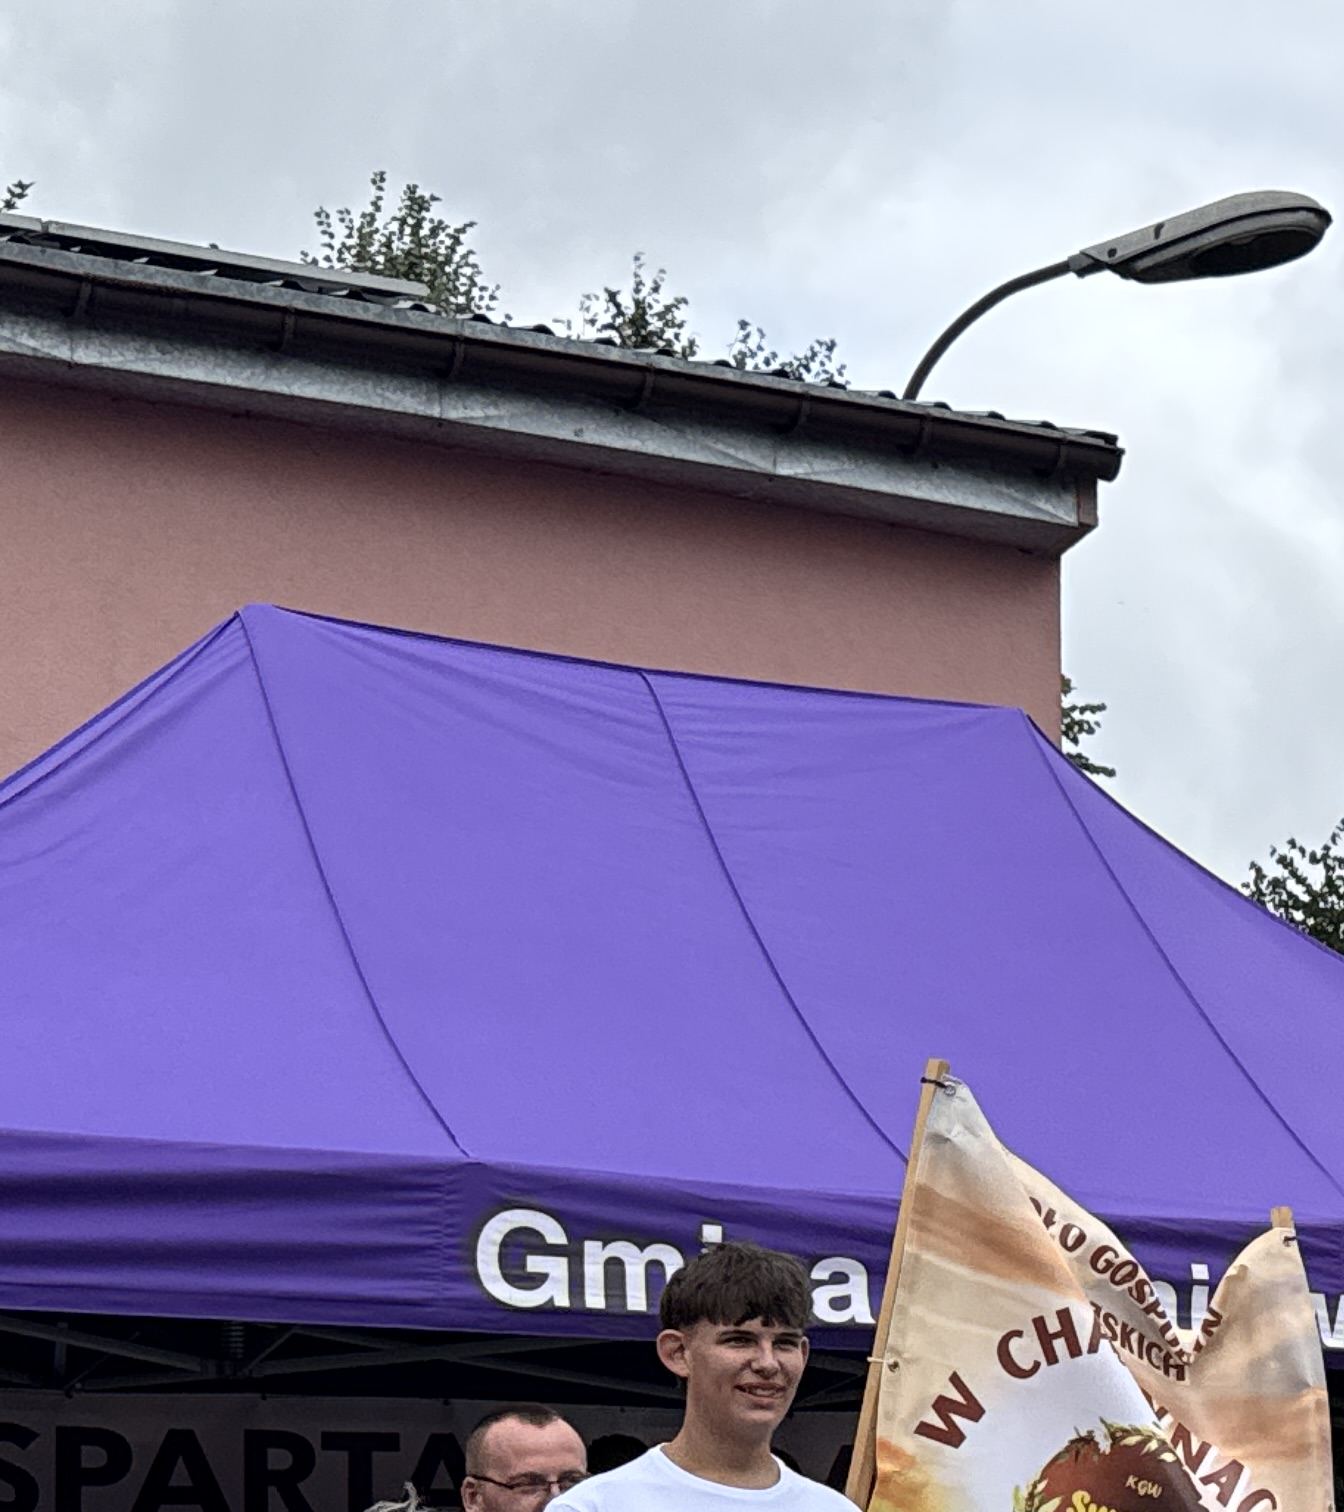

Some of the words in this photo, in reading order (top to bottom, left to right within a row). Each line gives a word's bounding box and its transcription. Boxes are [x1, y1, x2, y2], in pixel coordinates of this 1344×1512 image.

[474, 1207, 876, 1325] Gma
[914, 1371, 987, 1450] W
[1125, 1474, 1163, 1499] KGW
